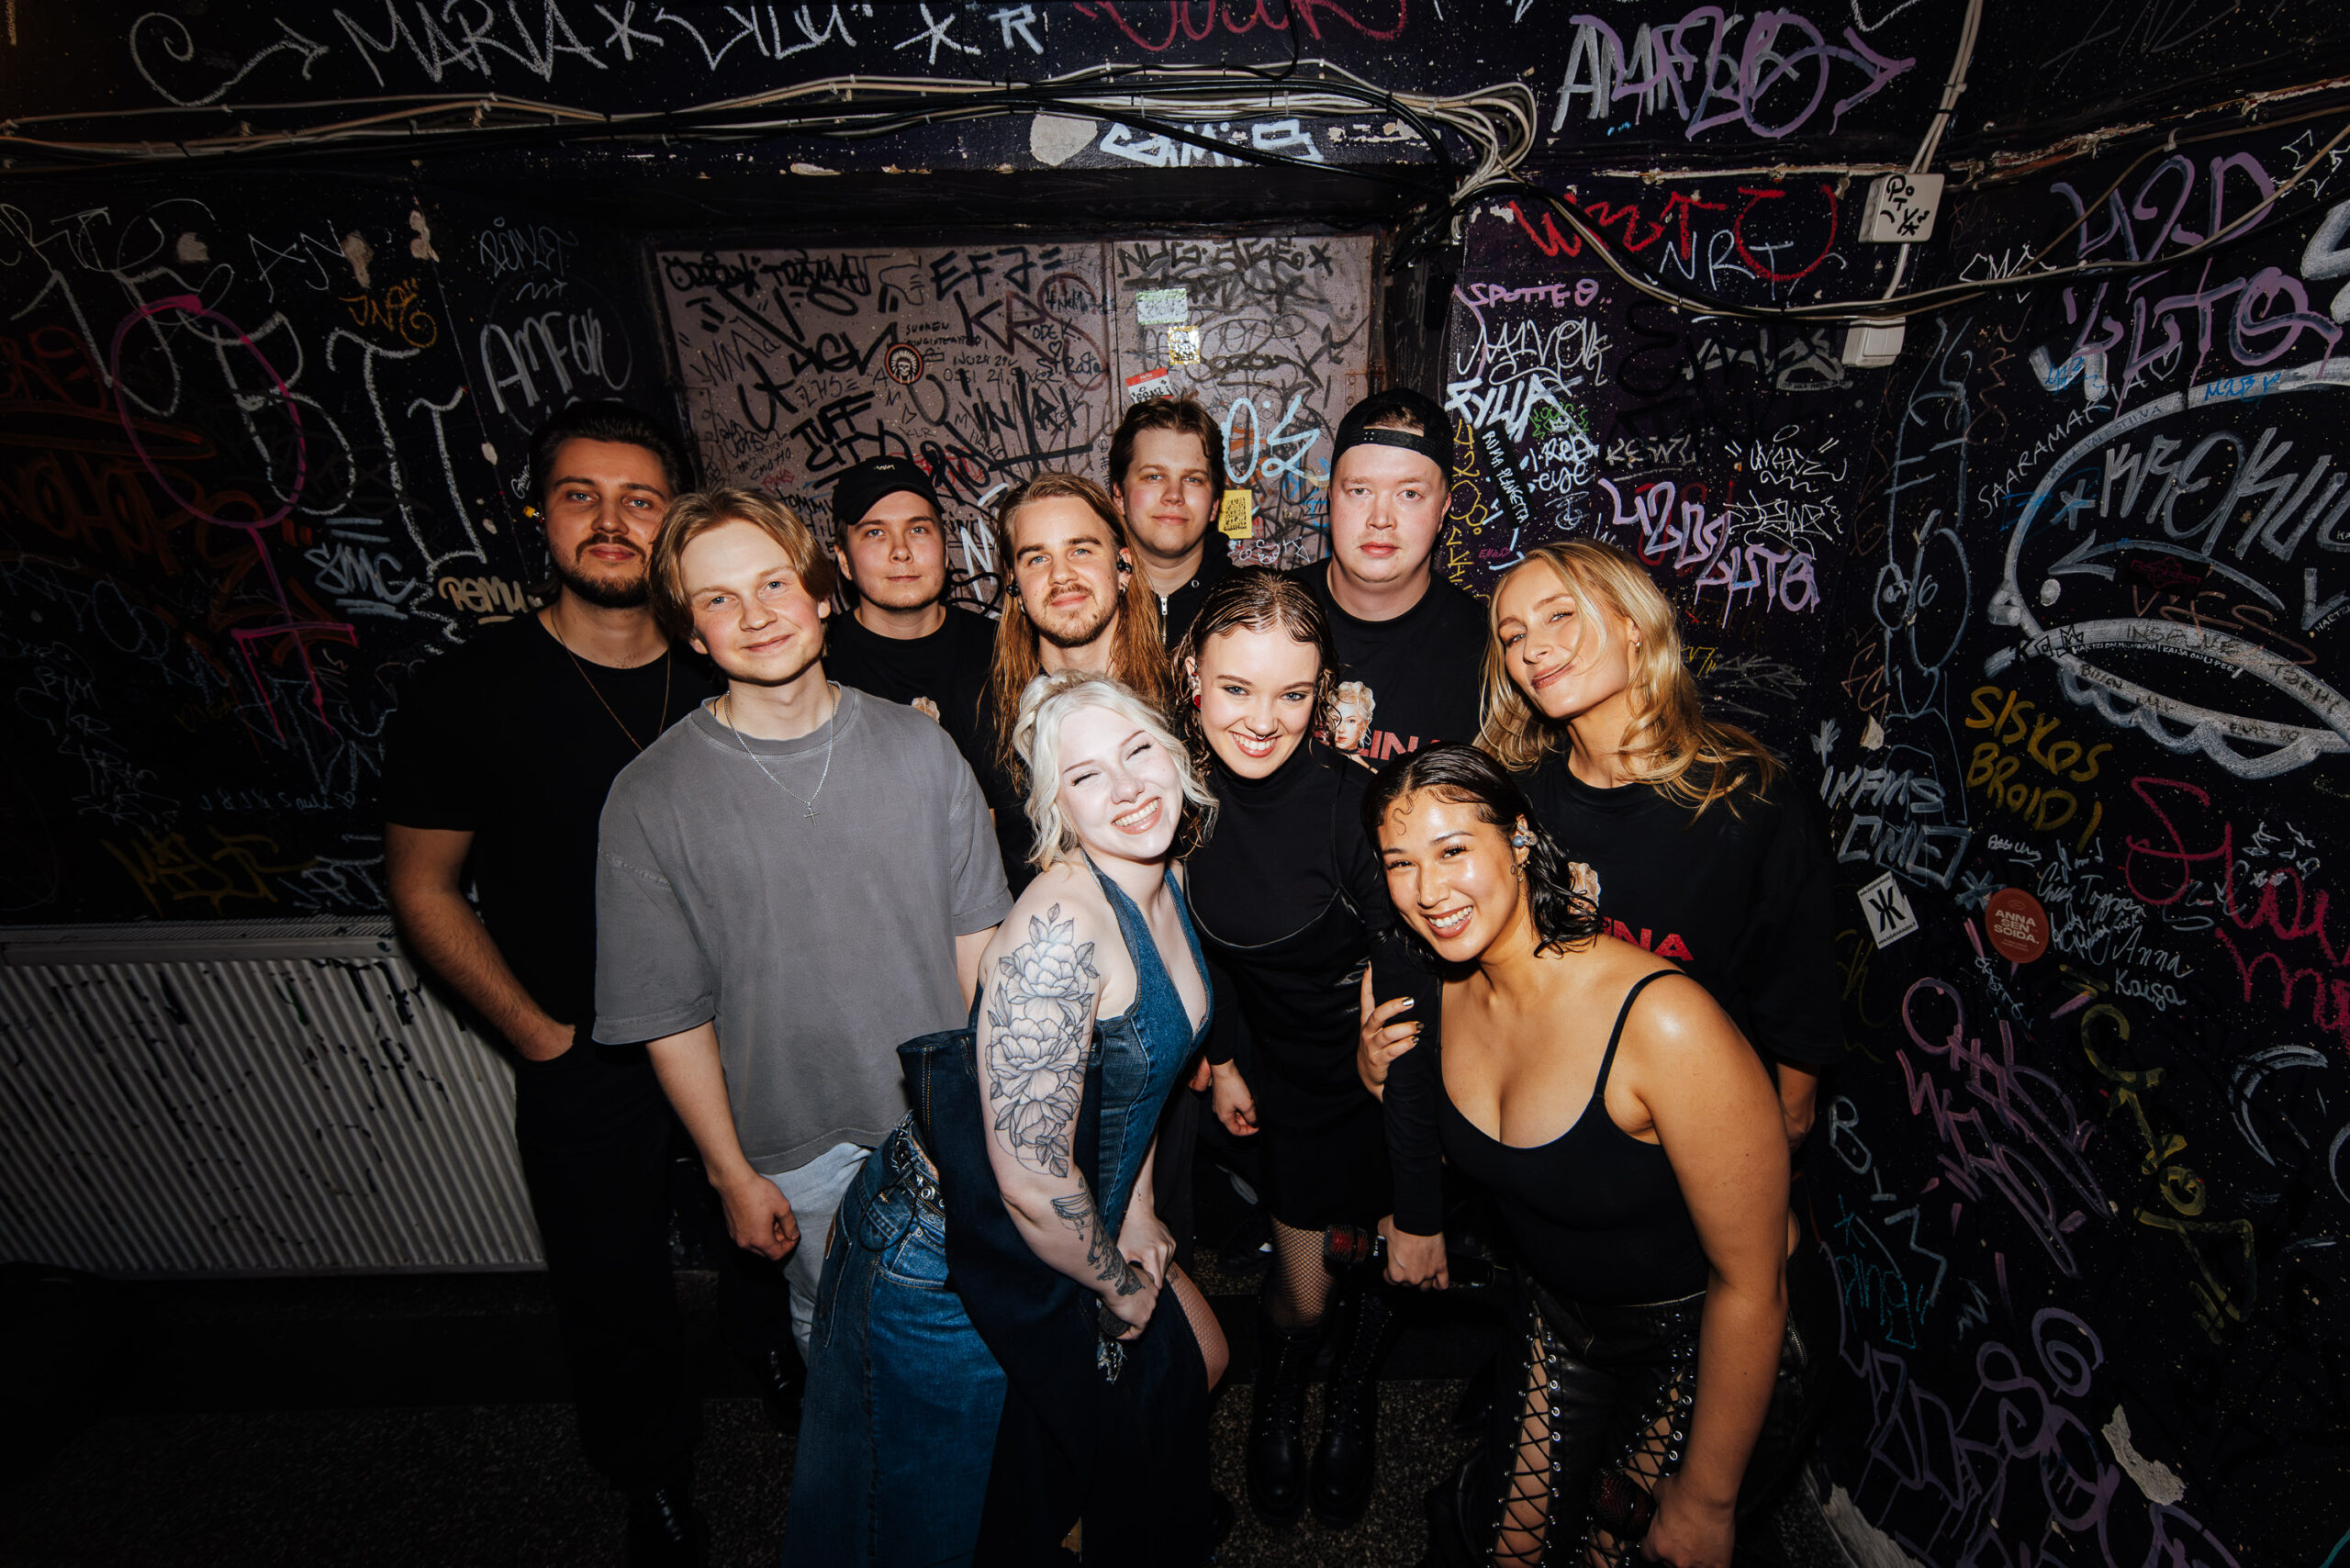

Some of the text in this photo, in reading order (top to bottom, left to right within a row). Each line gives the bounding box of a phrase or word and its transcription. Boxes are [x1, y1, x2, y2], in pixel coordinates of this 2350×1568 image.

[1964, 685, 2114, 782] SISKOS
[1994, 909, 2037, 927] ANNA
[2000, 918, 2031, 934] SEN
[1993, 924, 2040, 945] SOIDA.
